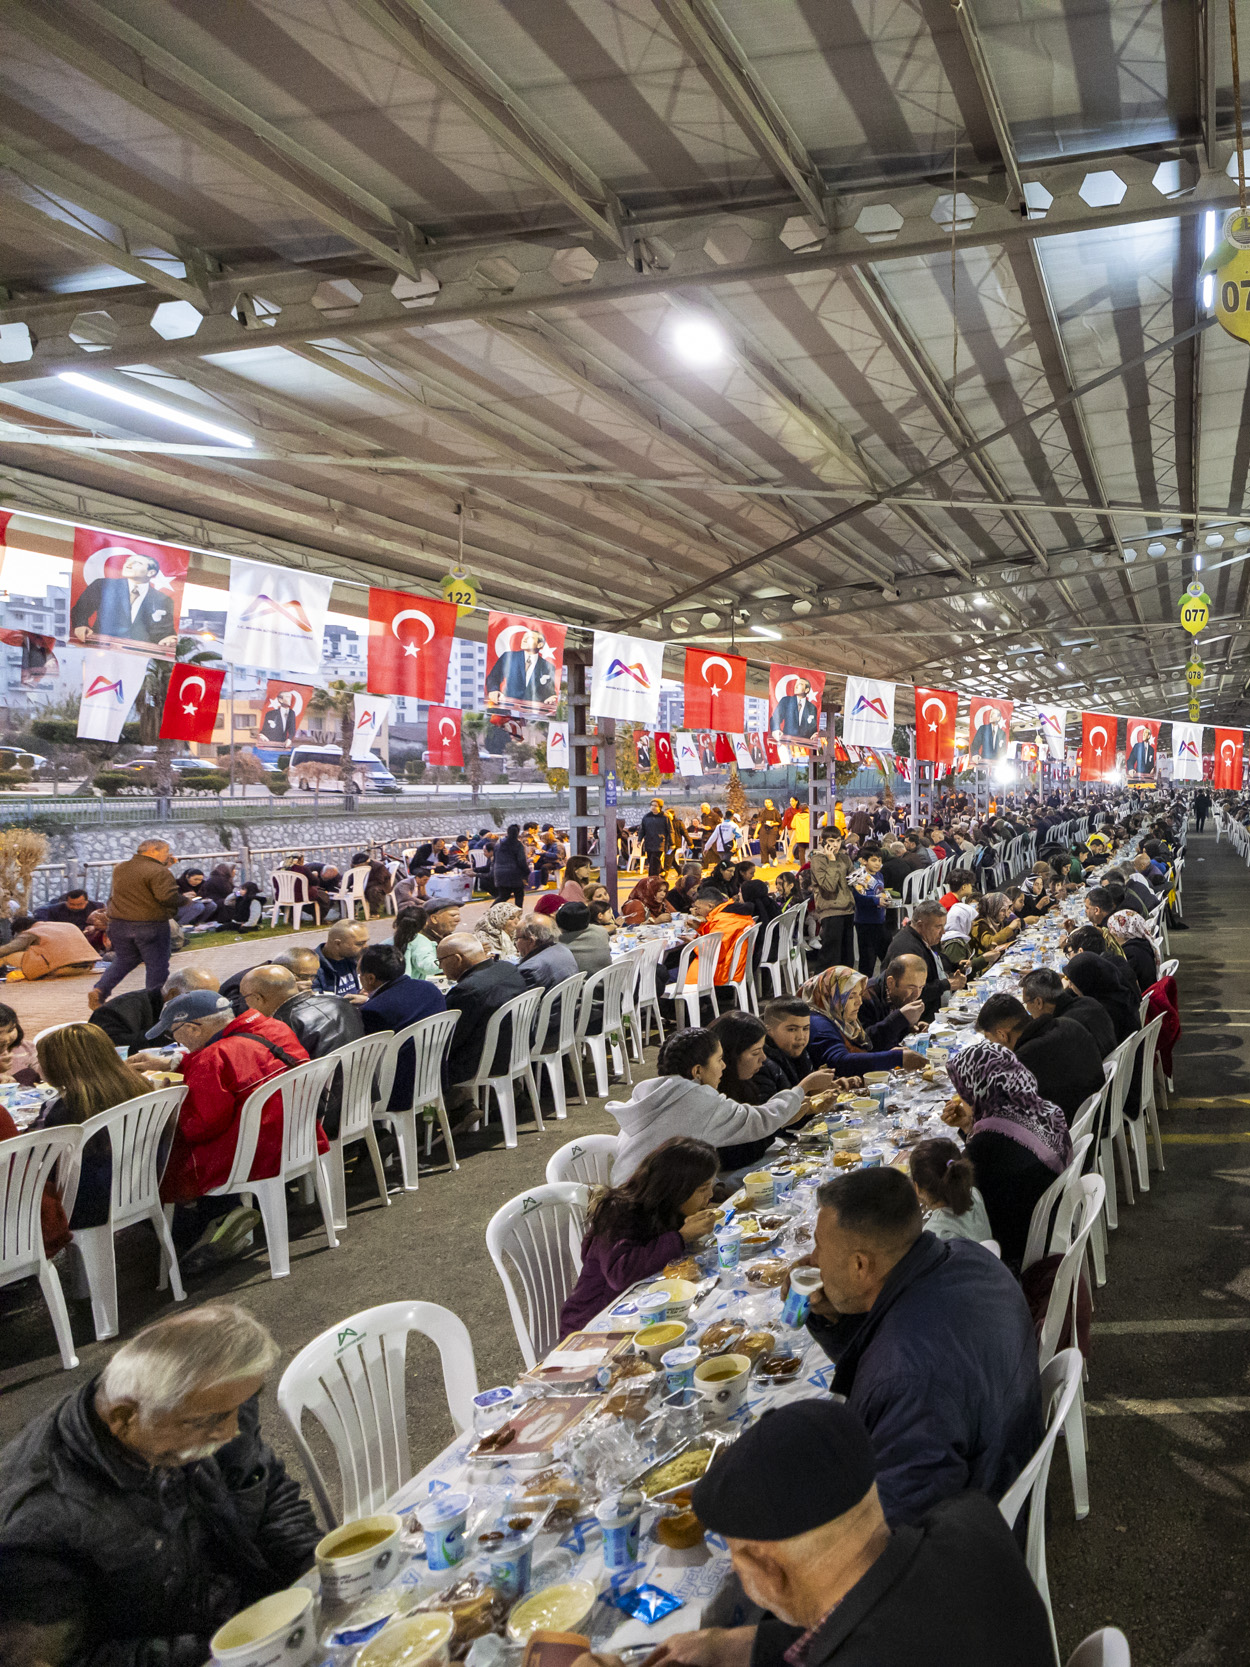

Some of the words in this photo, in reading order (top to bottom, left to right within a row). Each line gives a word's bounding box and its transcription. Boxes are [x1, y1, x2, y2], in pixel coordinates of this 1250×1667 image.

[447, 591, 472, 606] 122
[1184, 608, 1206, 622] 077
[1188, 670, 1202, 680] 078
